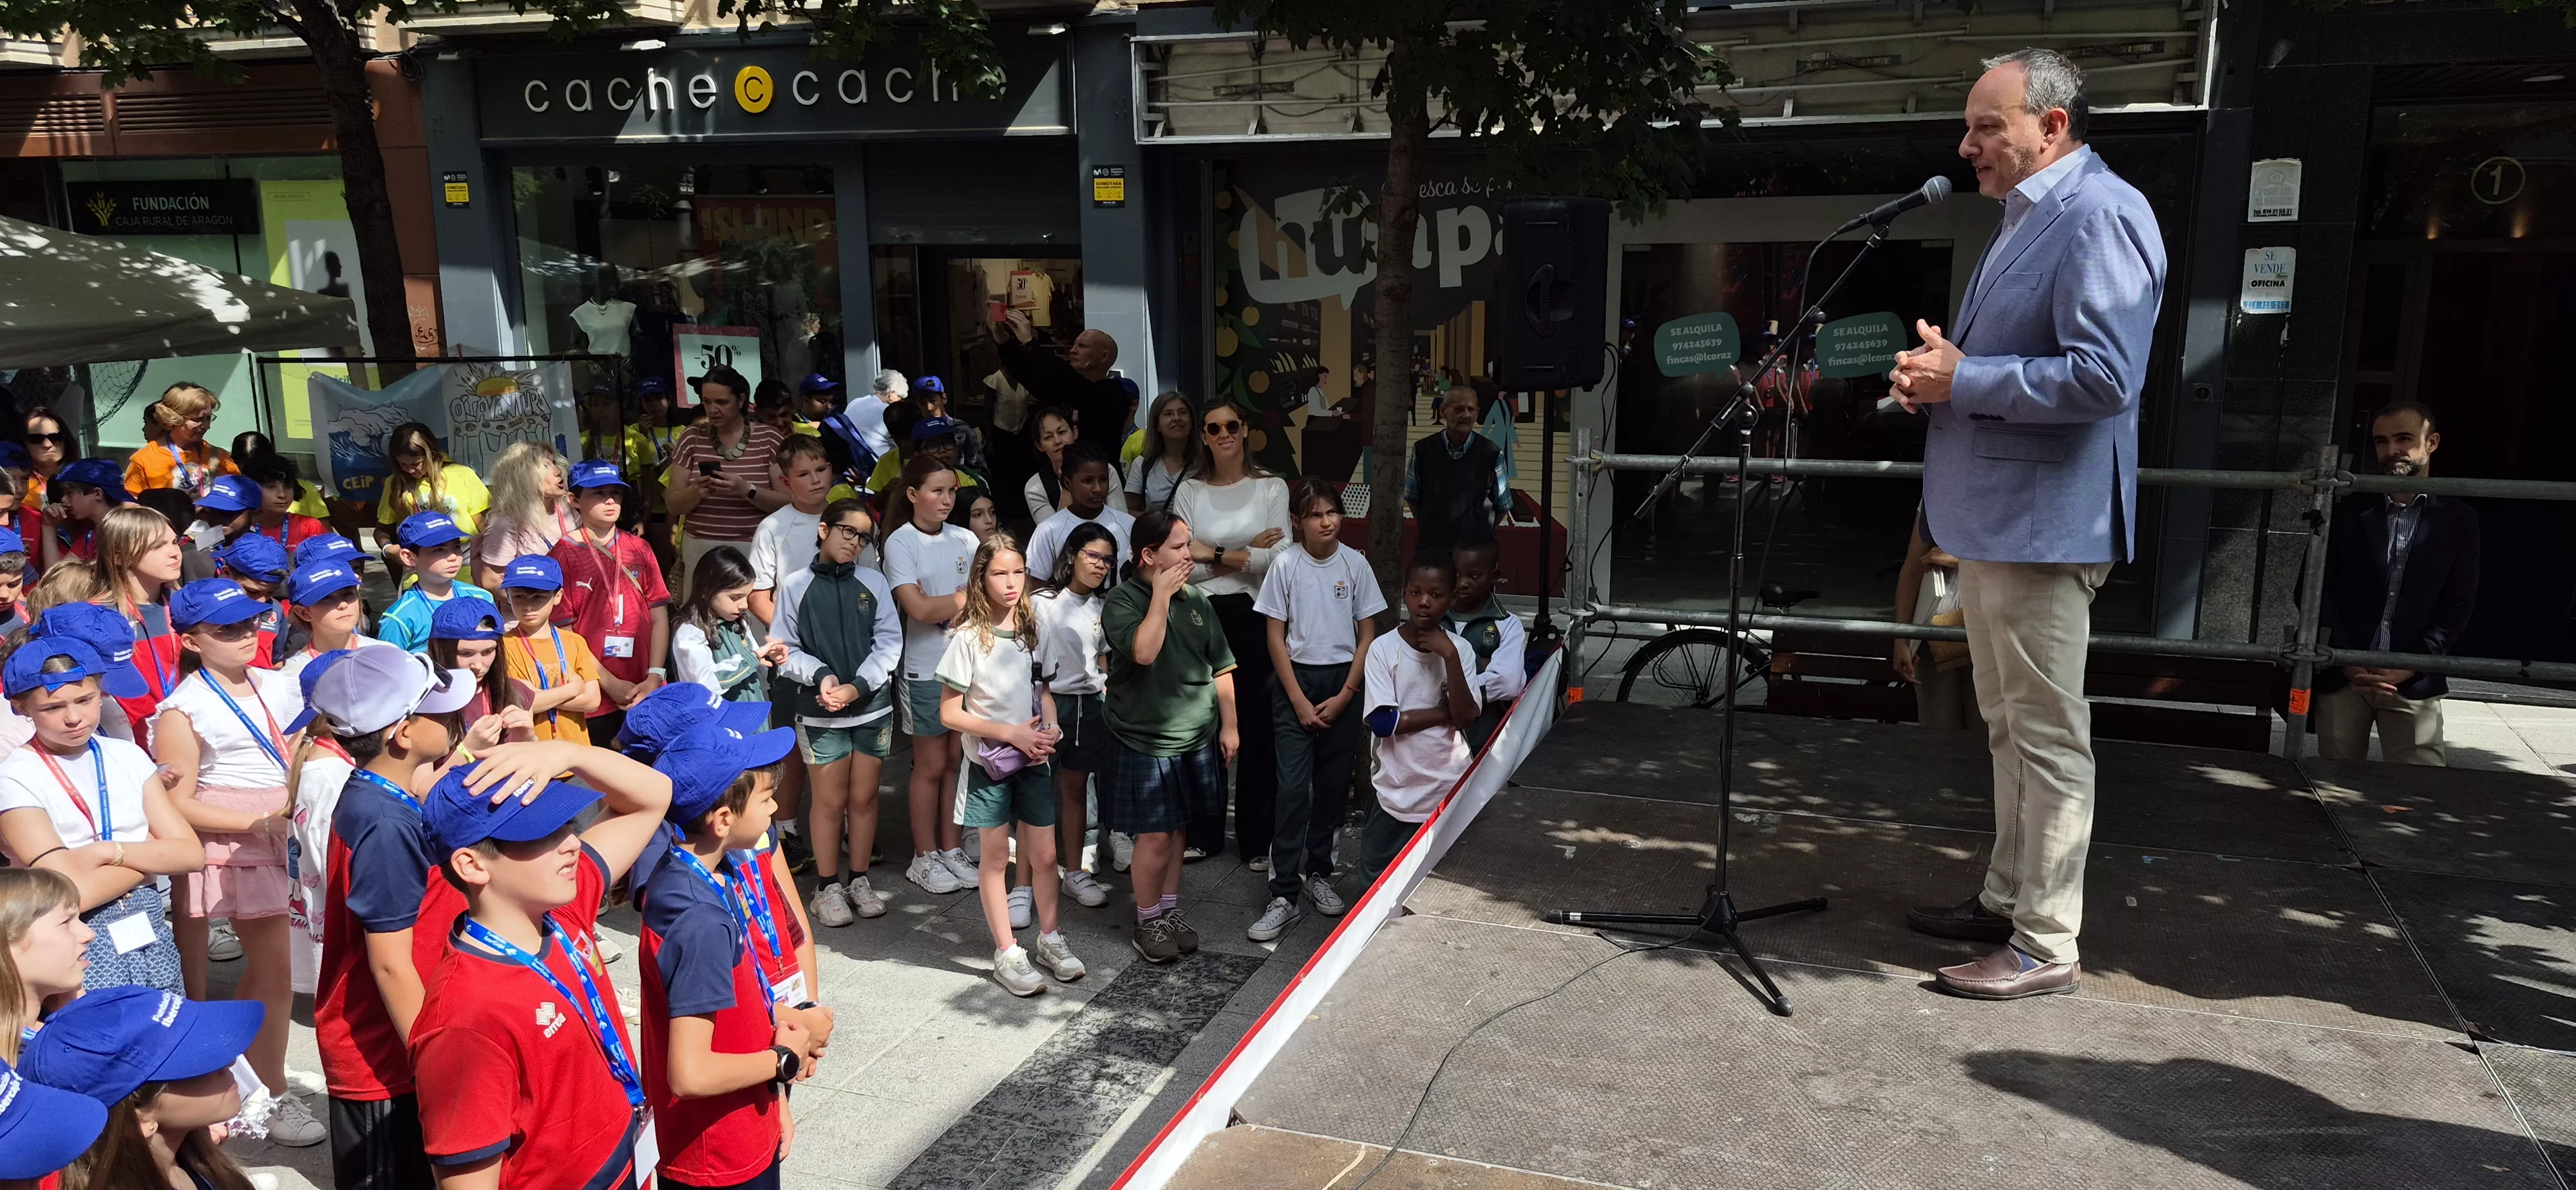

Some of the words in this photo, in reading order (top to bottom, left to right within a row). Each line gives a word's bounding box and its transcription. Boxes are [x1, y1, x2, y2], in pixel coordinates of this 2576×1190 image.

[524, 67, 718, 113] cache
[2490, 164, 2503, 196] 1
[132, 192, 210, 211] FUNDACIÓN
[115, 216, 140, 226] CAJA
[142, 216, 173, 226] RURAL
[176, 216, 189, 225] DE
[192, 213, 233, 225] ARAGÓN
[701, 207, 831, 241] ISLAND
[2264, 250, 2277, 261] SE
[2254, 263, 2286, 274] VENDE
[1670, 327, 1682, 337] SE
[1683, 323, 1723, 336] ALQUILA
[1833, 328, 1846, 337] SE
[1846, 324, 1889, 336] ALQUILA
[1672, 339, 1722, 350] 974245639
[1835, 339, 1888, 351] 974245639
[543, 1012, 567, 1039] errea
